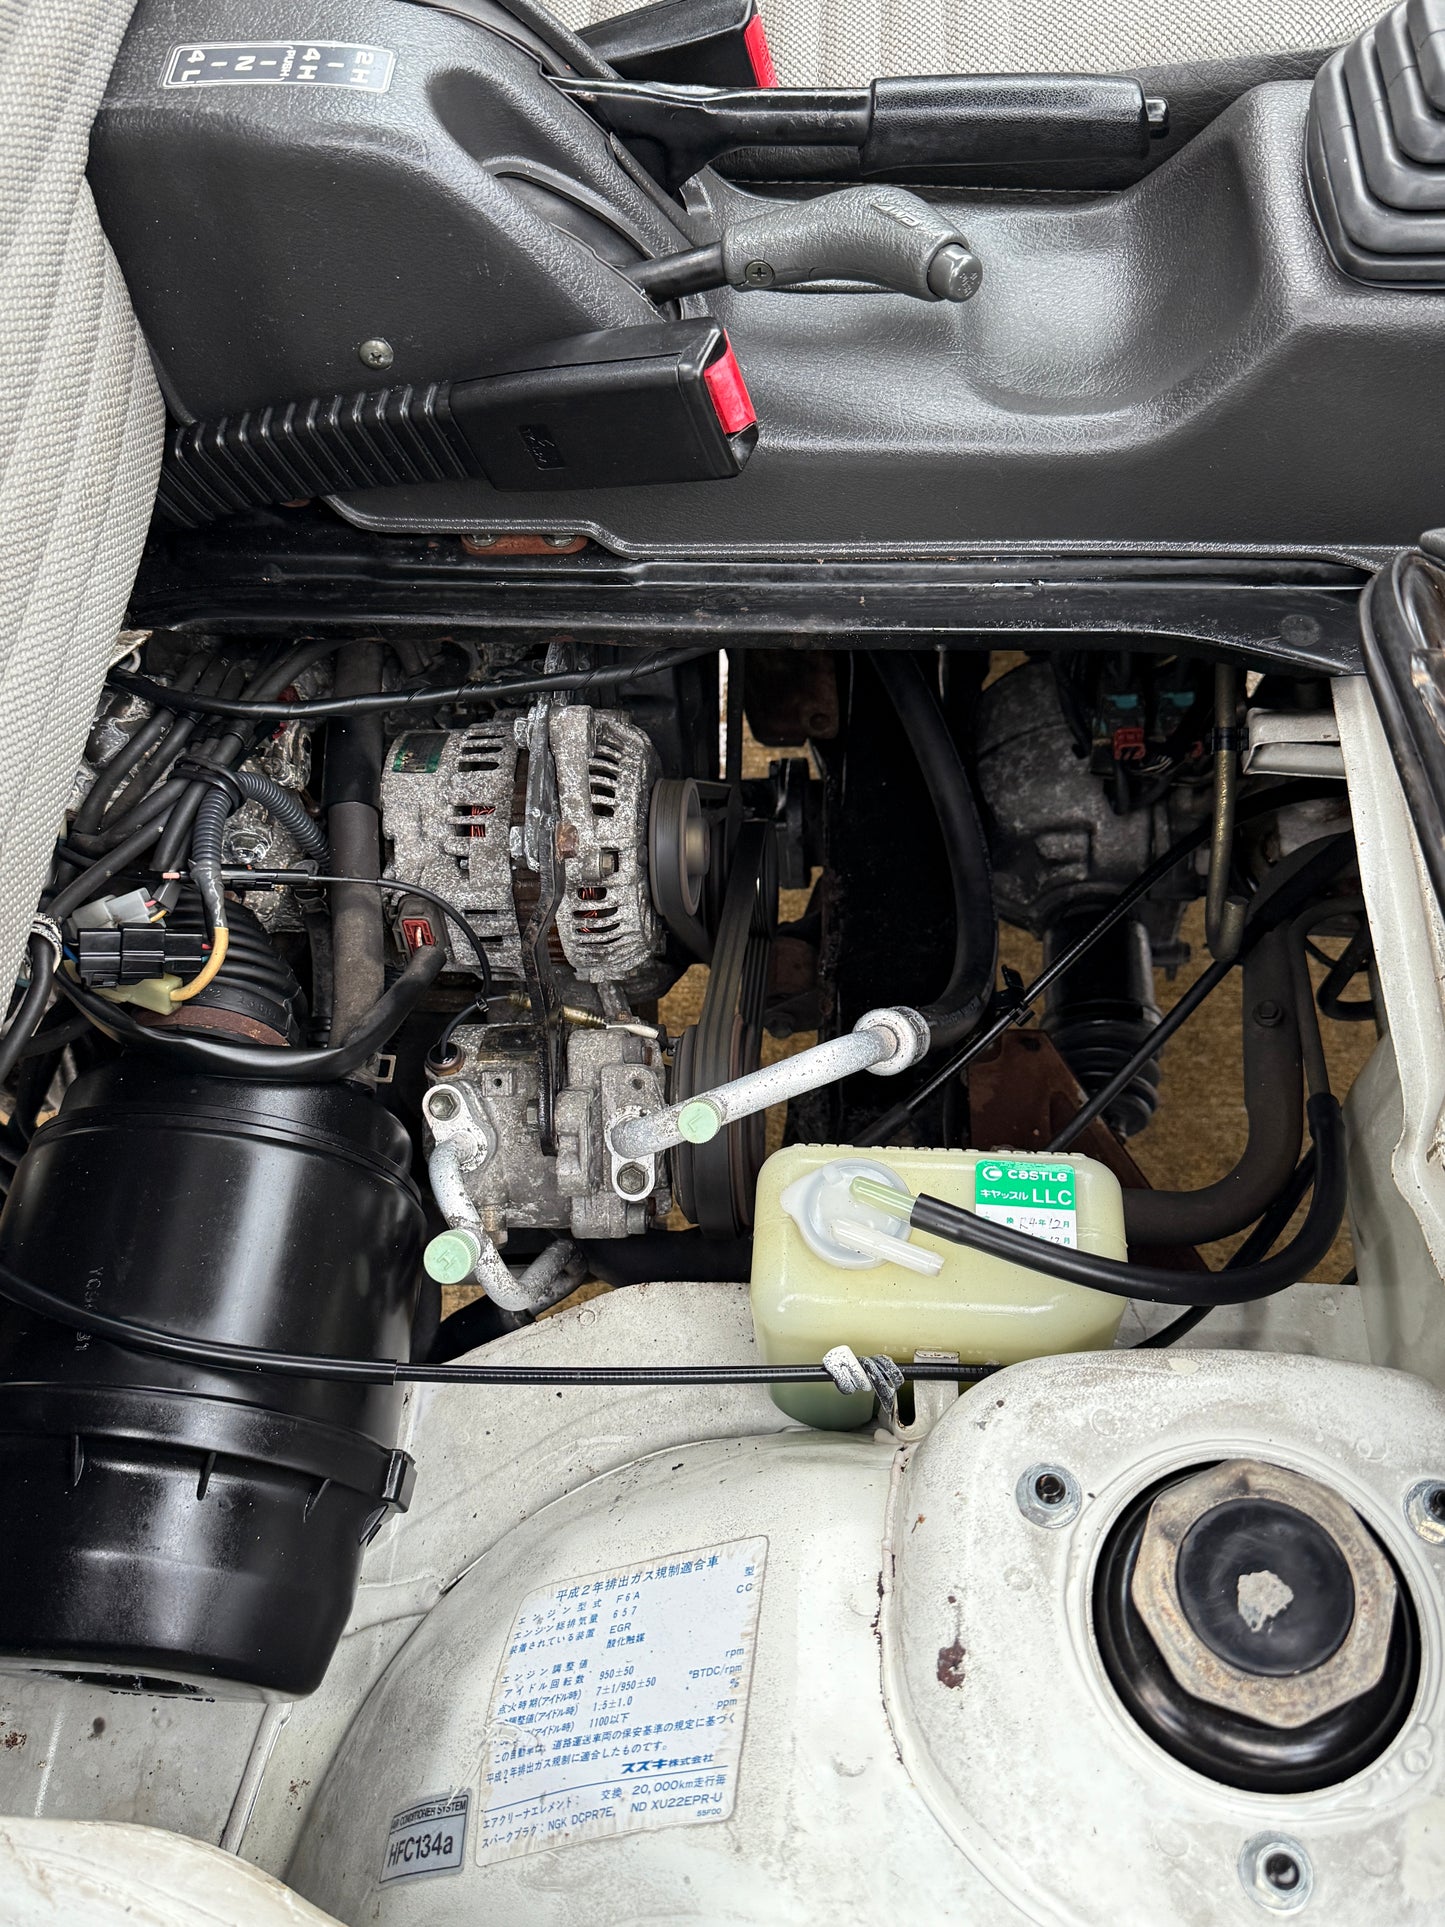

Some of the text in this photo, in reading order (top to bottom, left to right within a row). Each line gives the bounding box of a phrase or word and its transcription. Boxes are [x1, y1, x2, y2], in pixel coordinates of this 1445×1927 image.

[234, 56, 257, 71] N
[280, 49, 297, 77] PUSH
[297, 48, 321, 79] 4H
[350, 51, 374, 83] 2H
[1032, 1188, 1072, 1206] LLC
[556, 1555, 719, 1601] 平成2年排出ガス規制適合車
[616, 1591, 640, 1604] F6A
[514, 1613, 598, 1640] エンジン総排気量
[612, 1605, 638, 1619] 657
[609, 1622, 632, 1634] EGR
[504, 1647, 745, 1698] アイドル回転数 950±50 rpm
[596, 1676, 657, 1696] 7±1/950±50
[593, 1695, 633, 1711] 1.5±1.0
[729, 1677, 740, 1688] %
[589, 1712, 631, 1728] 1100以下
[716, 1698, 738, 1709] ppm
[621, 1754, 714, 1774] スズキ株式会社
[437, 1800, 466, 1815] SYSTEM
[548, 1817, 568, 1831] NGK
[630, 1801, 647, 1813] ND
[651, 1792, 722, 1811] XU22EPR-U
[387, 1831, 454, 1867] HFC134a
